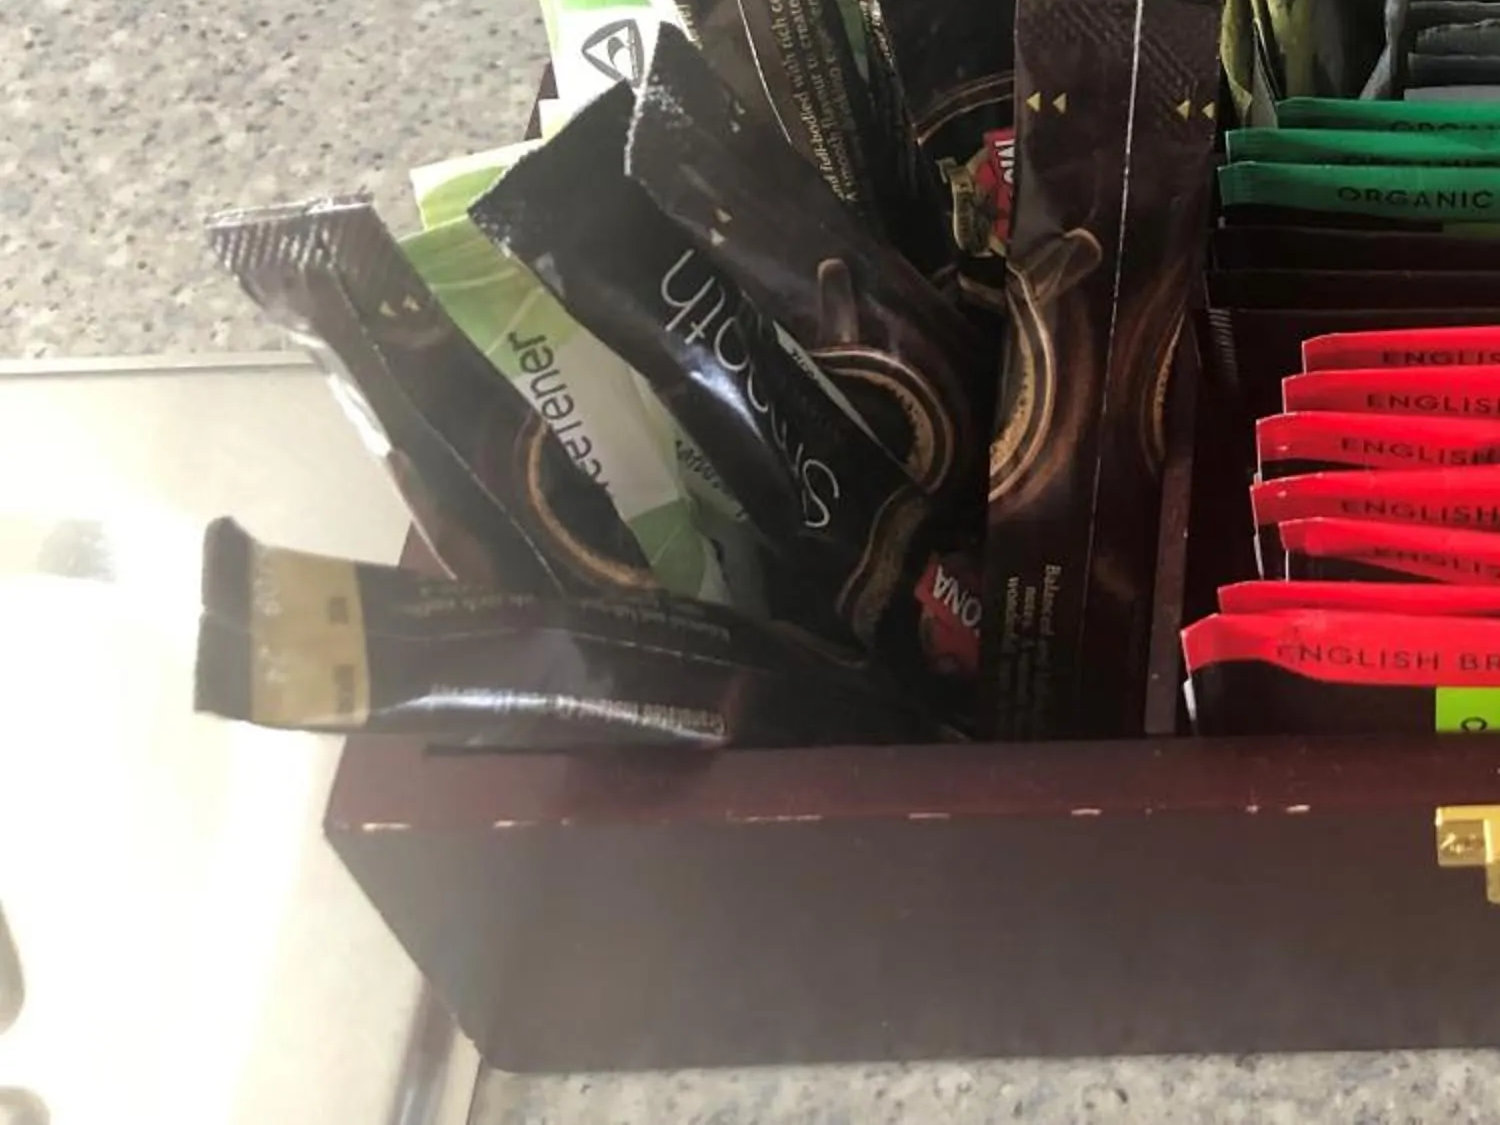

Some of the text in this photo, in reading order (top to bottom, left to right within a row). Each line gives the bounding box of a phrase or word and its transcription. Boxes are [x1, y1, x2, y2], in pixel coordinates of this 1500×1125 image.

[1337, 186, 1495, 209] ORGANIC
[1339, 436, 1495, 466] ENGLISH
[1276, 644, 1440, 672] ENGLISH
